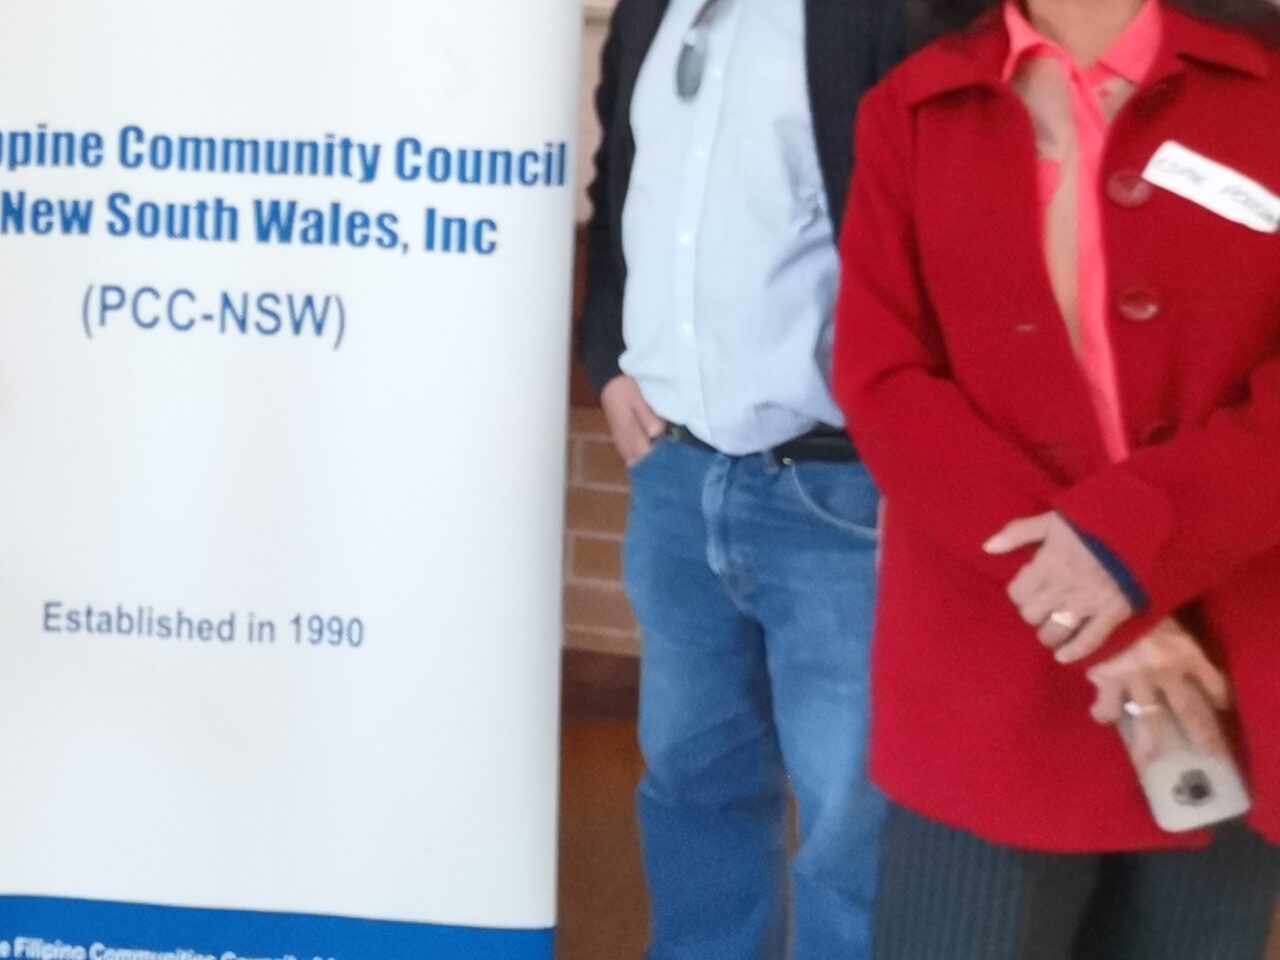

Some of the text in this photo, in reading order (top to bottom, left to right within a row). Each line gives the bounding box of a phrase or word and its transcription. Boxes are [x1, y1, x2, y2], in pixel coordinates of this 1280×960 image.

[118, 125, 381, 183] Community
[395, 137, 566, 186] Council
[0, 190, 94, 236] New
[107, 192, 239, 242] South
[253, 199, 408, 254] Wales,
[424, 207, 497, 255] Inc
[81, 284, 346, 351] (PCC-NSW)
[42, 601, 365, 647] Established in 1990
